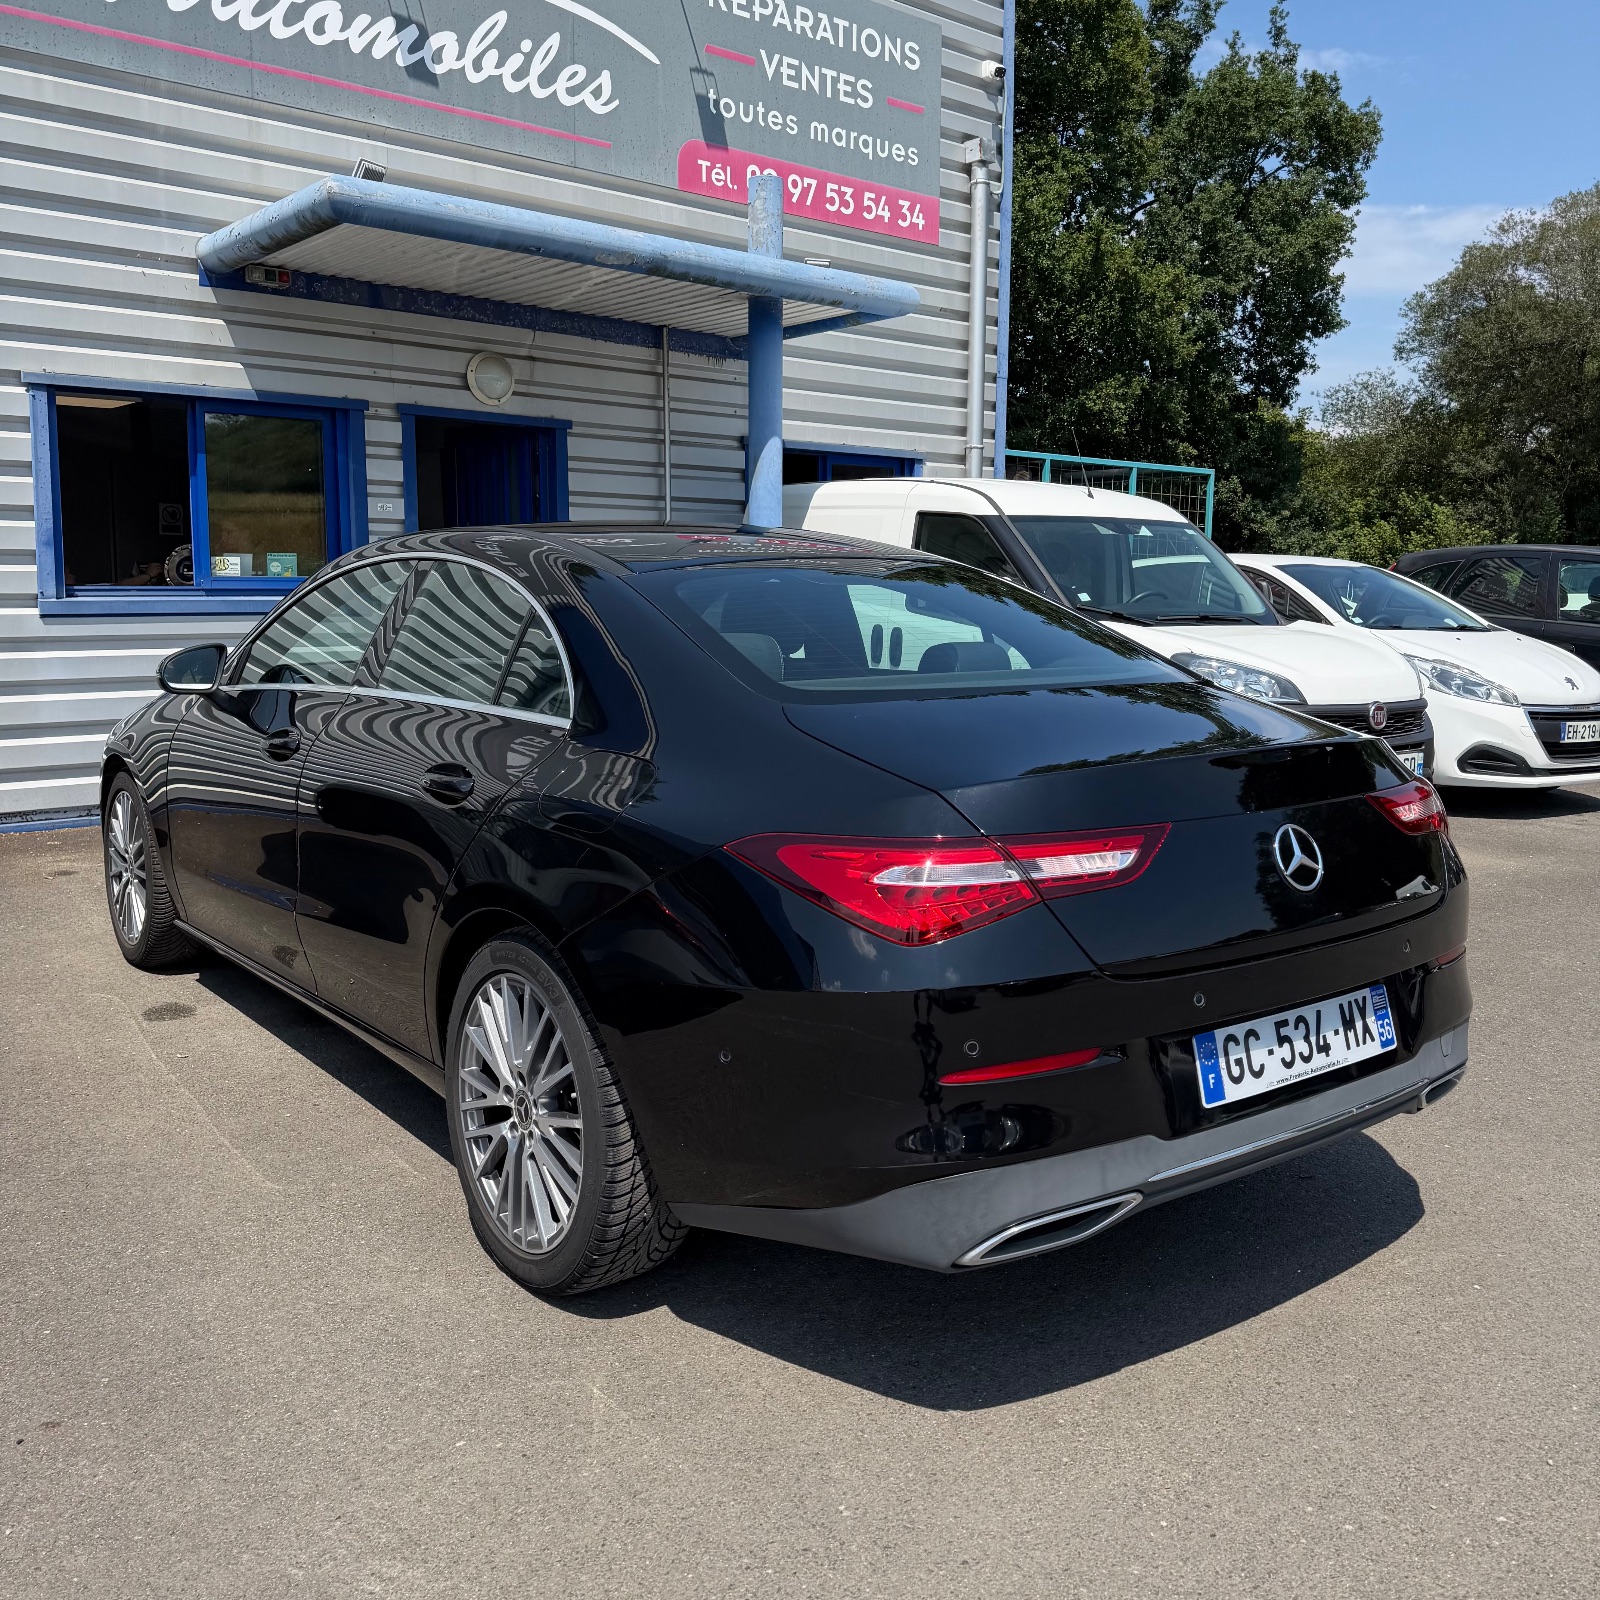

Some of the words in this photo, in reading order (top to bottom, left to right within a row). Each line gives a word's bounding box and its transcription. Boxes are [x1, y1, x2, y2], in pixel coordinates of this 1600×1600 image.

[106, 0, 619, 115] utomobiles
[759, 48, 874, 109] VENTES
[708, 88, 798, 135] toutes
[810, 121, 919, 167] marques
[697, 159, 738, 190] Tél.
[787, 174, 818, 206] 97
[825, 183, 855, 215] 53
[862, 192, 891, 223] 54
[897, 200, 926, 231] 34
[1567, 723, 1600, 740] EH-219-
[1222, 995, 1376, 1085] GC-534-MX
[1377, 1018, 1393, 1042] 56
[1208, 1073, 1216, 1089] F
